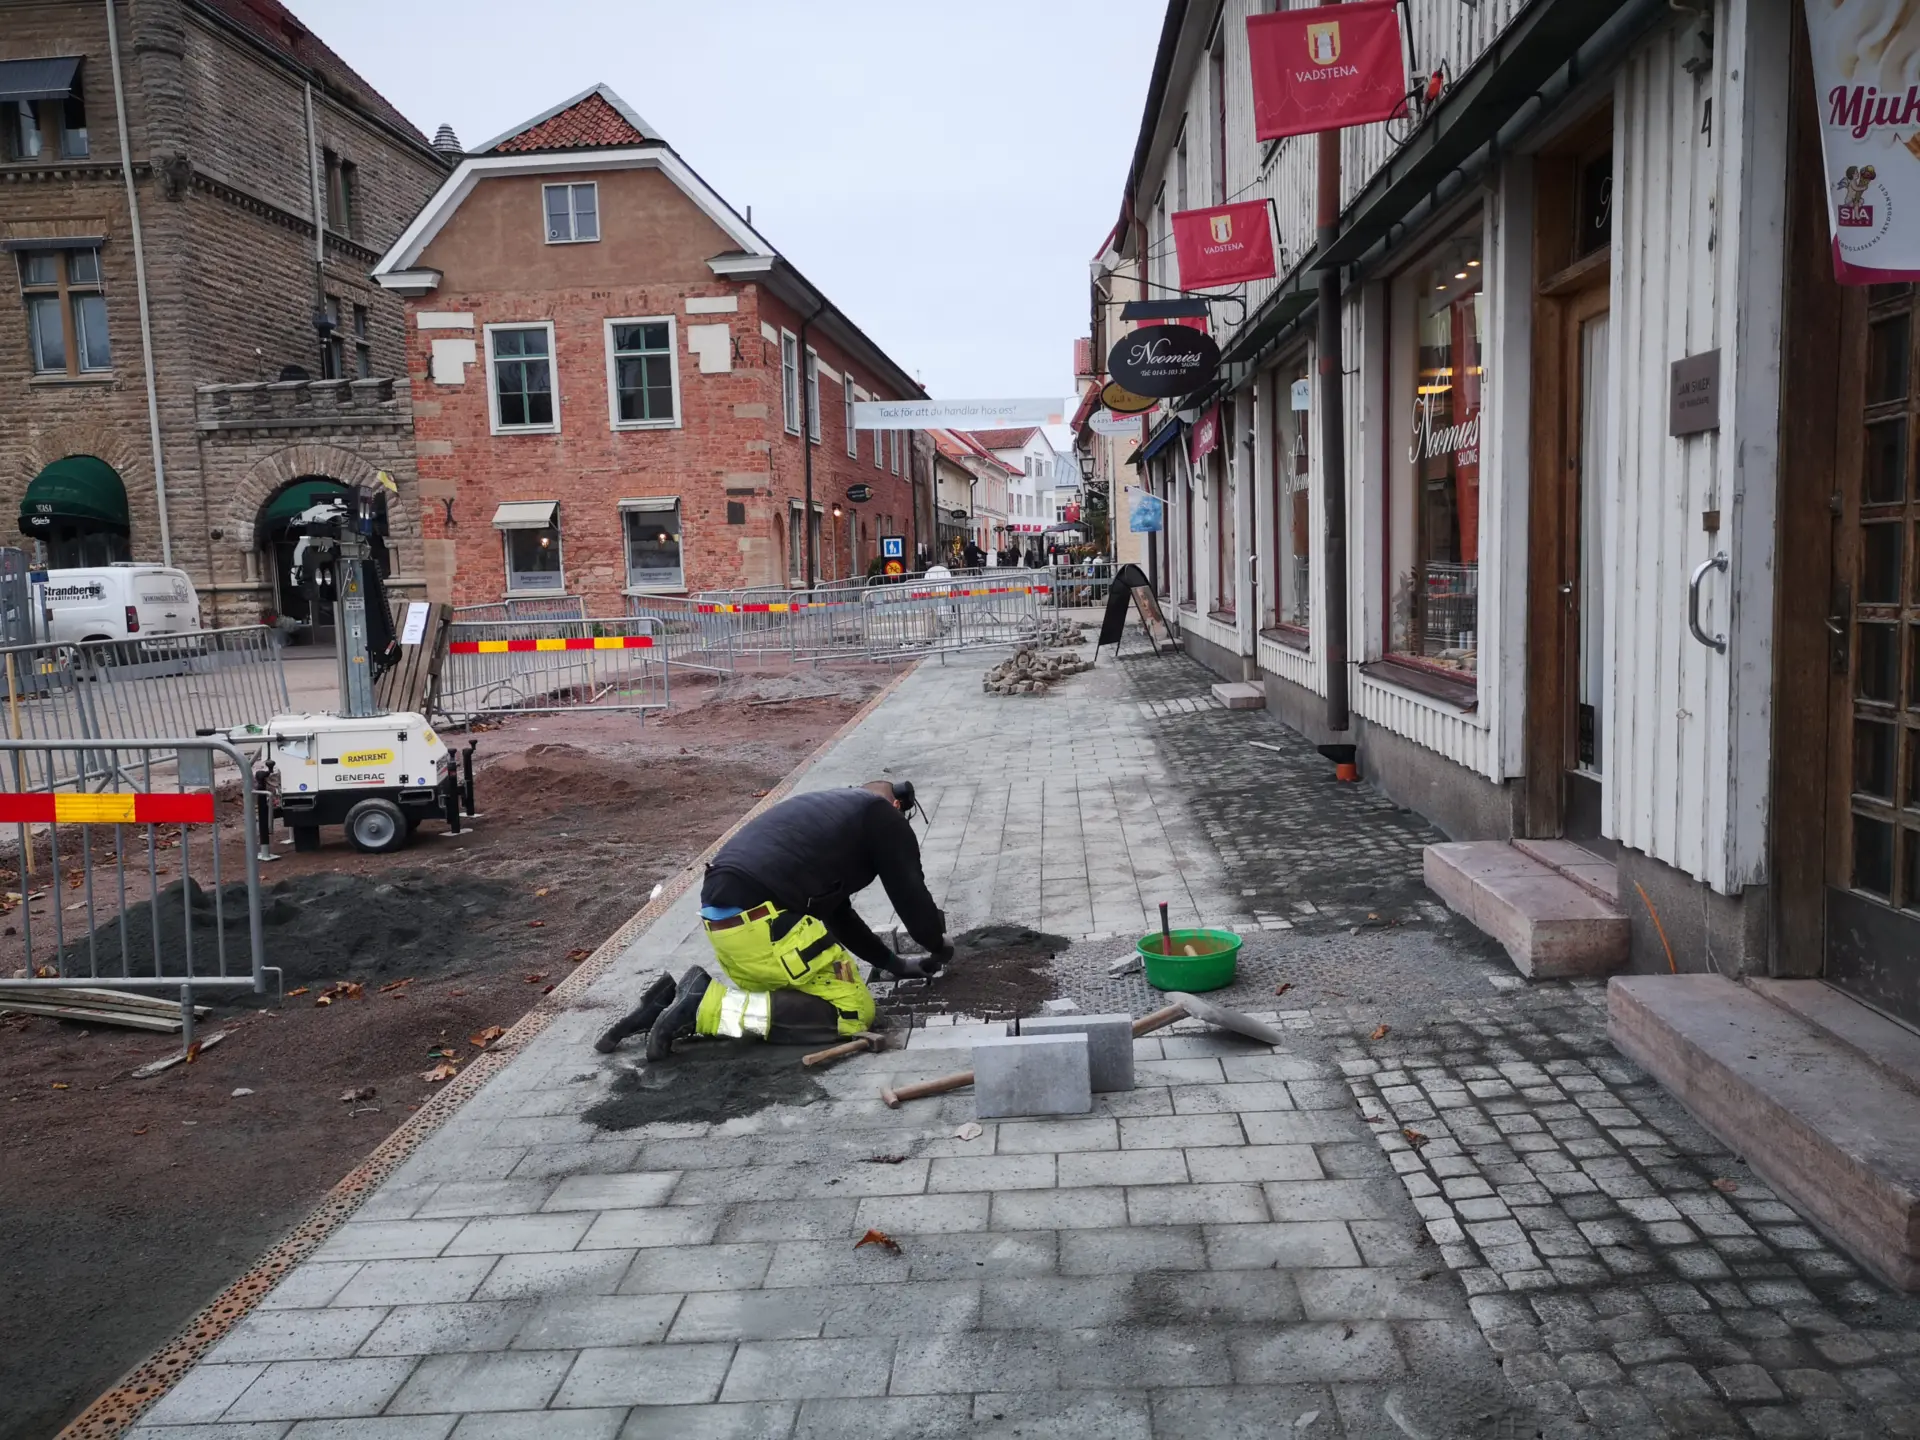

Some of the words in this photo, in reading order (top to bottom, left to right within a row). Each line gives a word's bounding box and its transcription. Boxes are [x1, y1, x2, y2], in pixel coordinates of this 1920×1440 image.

[1295, 64, 1359, 83] VADSTENA
[1701, 97, 1713, 148] 4
[1840, 208, 1870, 220] SIA
[1203, 242, 1245, 255] VADSTENA
[1126, 337, 1203, 366] Noomies
[879, 407, 899, 417] Tack
[900, 407, 914, 418] för
[915, 408, 929, 417] att
[930, 407, 943, 416] du
[944, 405, 979, 416] handlar
[981, 405, 997, 415] hos
[998, 406, 1017, 415] oss!
[1408, 367, 1482, 464] Noomies
[1458, 448, 1478, 467] SALONG
[44, 584, 101, 597] Strandbergs
[347, 752, 388, 763] RAMIRENT
[335, 773, 385, 782] GENERAC
